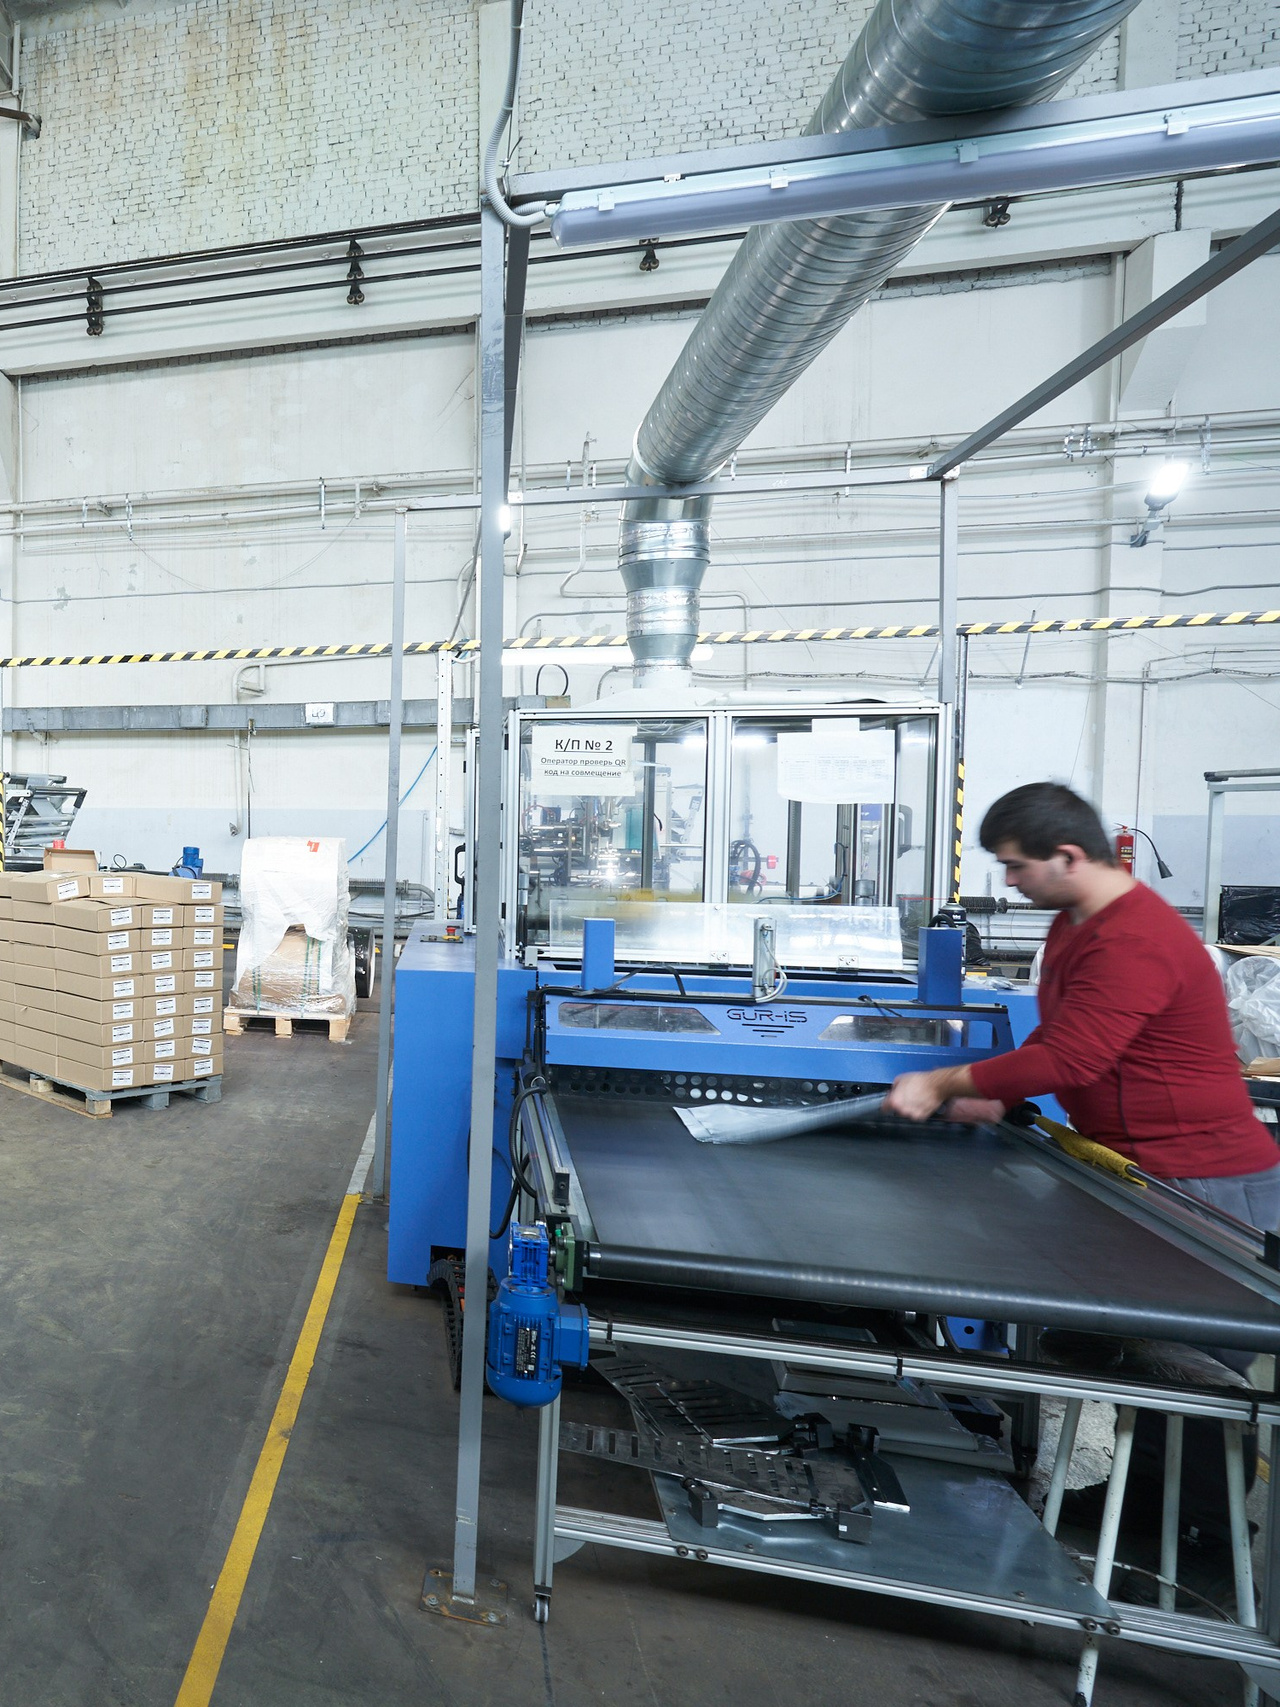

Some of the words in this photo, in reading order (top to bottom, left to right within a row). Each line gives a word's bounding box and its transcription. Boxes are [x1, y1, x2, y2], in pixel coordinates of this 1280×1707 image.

[555, 738, 580, 752] К/П
[585, 740, 601, 751] №
[605, 740, 613, 751] 2
[540, 757, 578, 766] Оператор
[580, 759, 613, 767] проверь
[614, 759, 627, 767] QR
